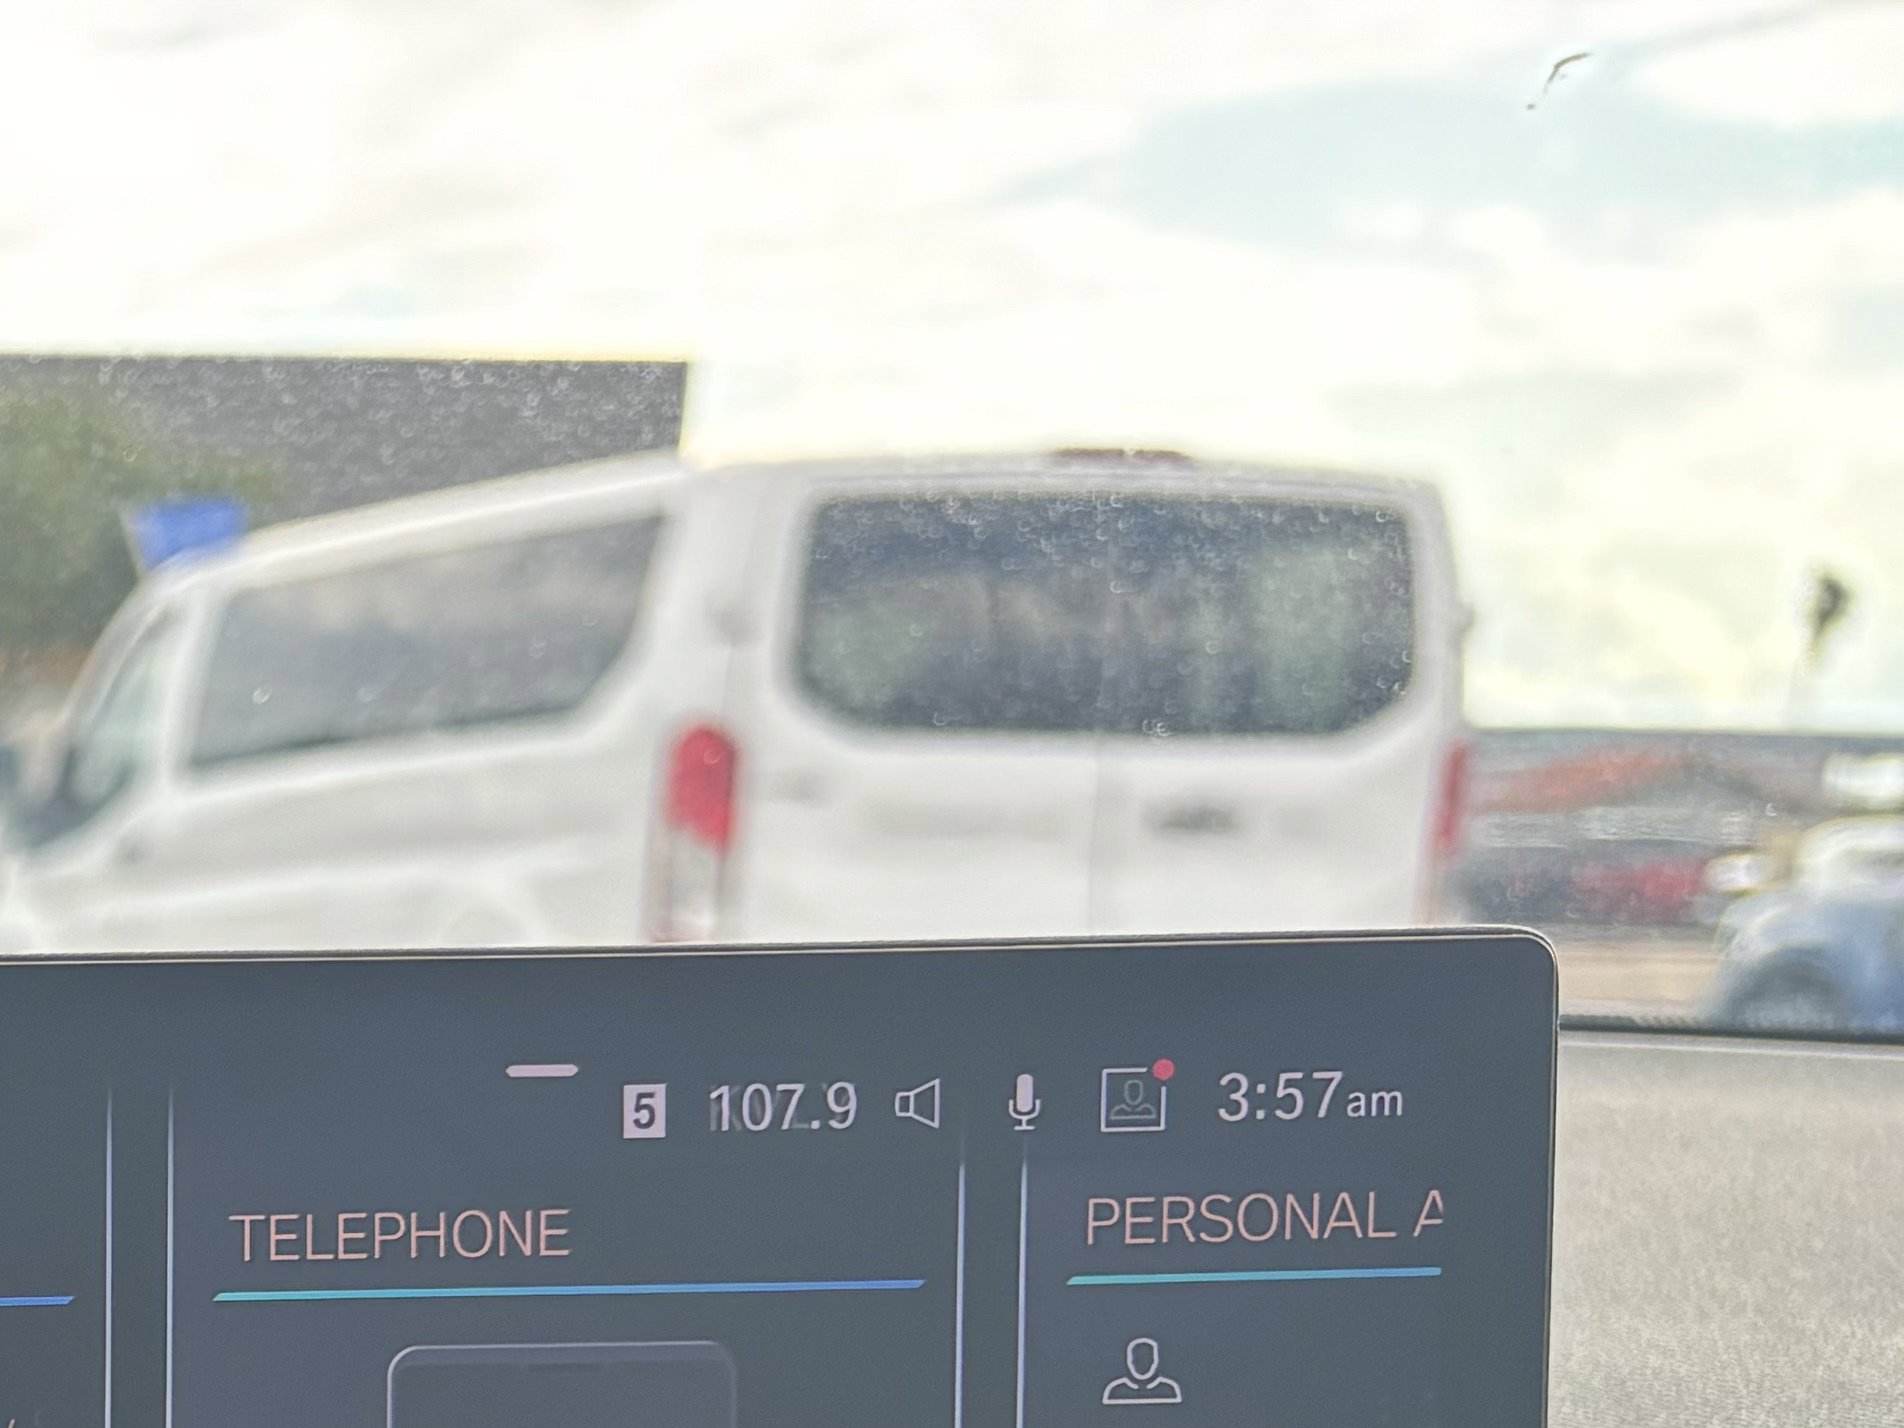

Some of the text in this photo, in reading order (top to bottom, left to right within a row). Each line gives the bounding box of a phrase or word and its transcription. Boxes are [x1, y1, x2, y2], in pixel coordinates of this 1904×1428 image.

[632, 1091, 657, 1130] 5
[708, 1081, 859, 1132] 107.9
[228, 1208, 573, 1262] TELEPHONE
[1086, 1190, 1398, 1246] PERSONAL
